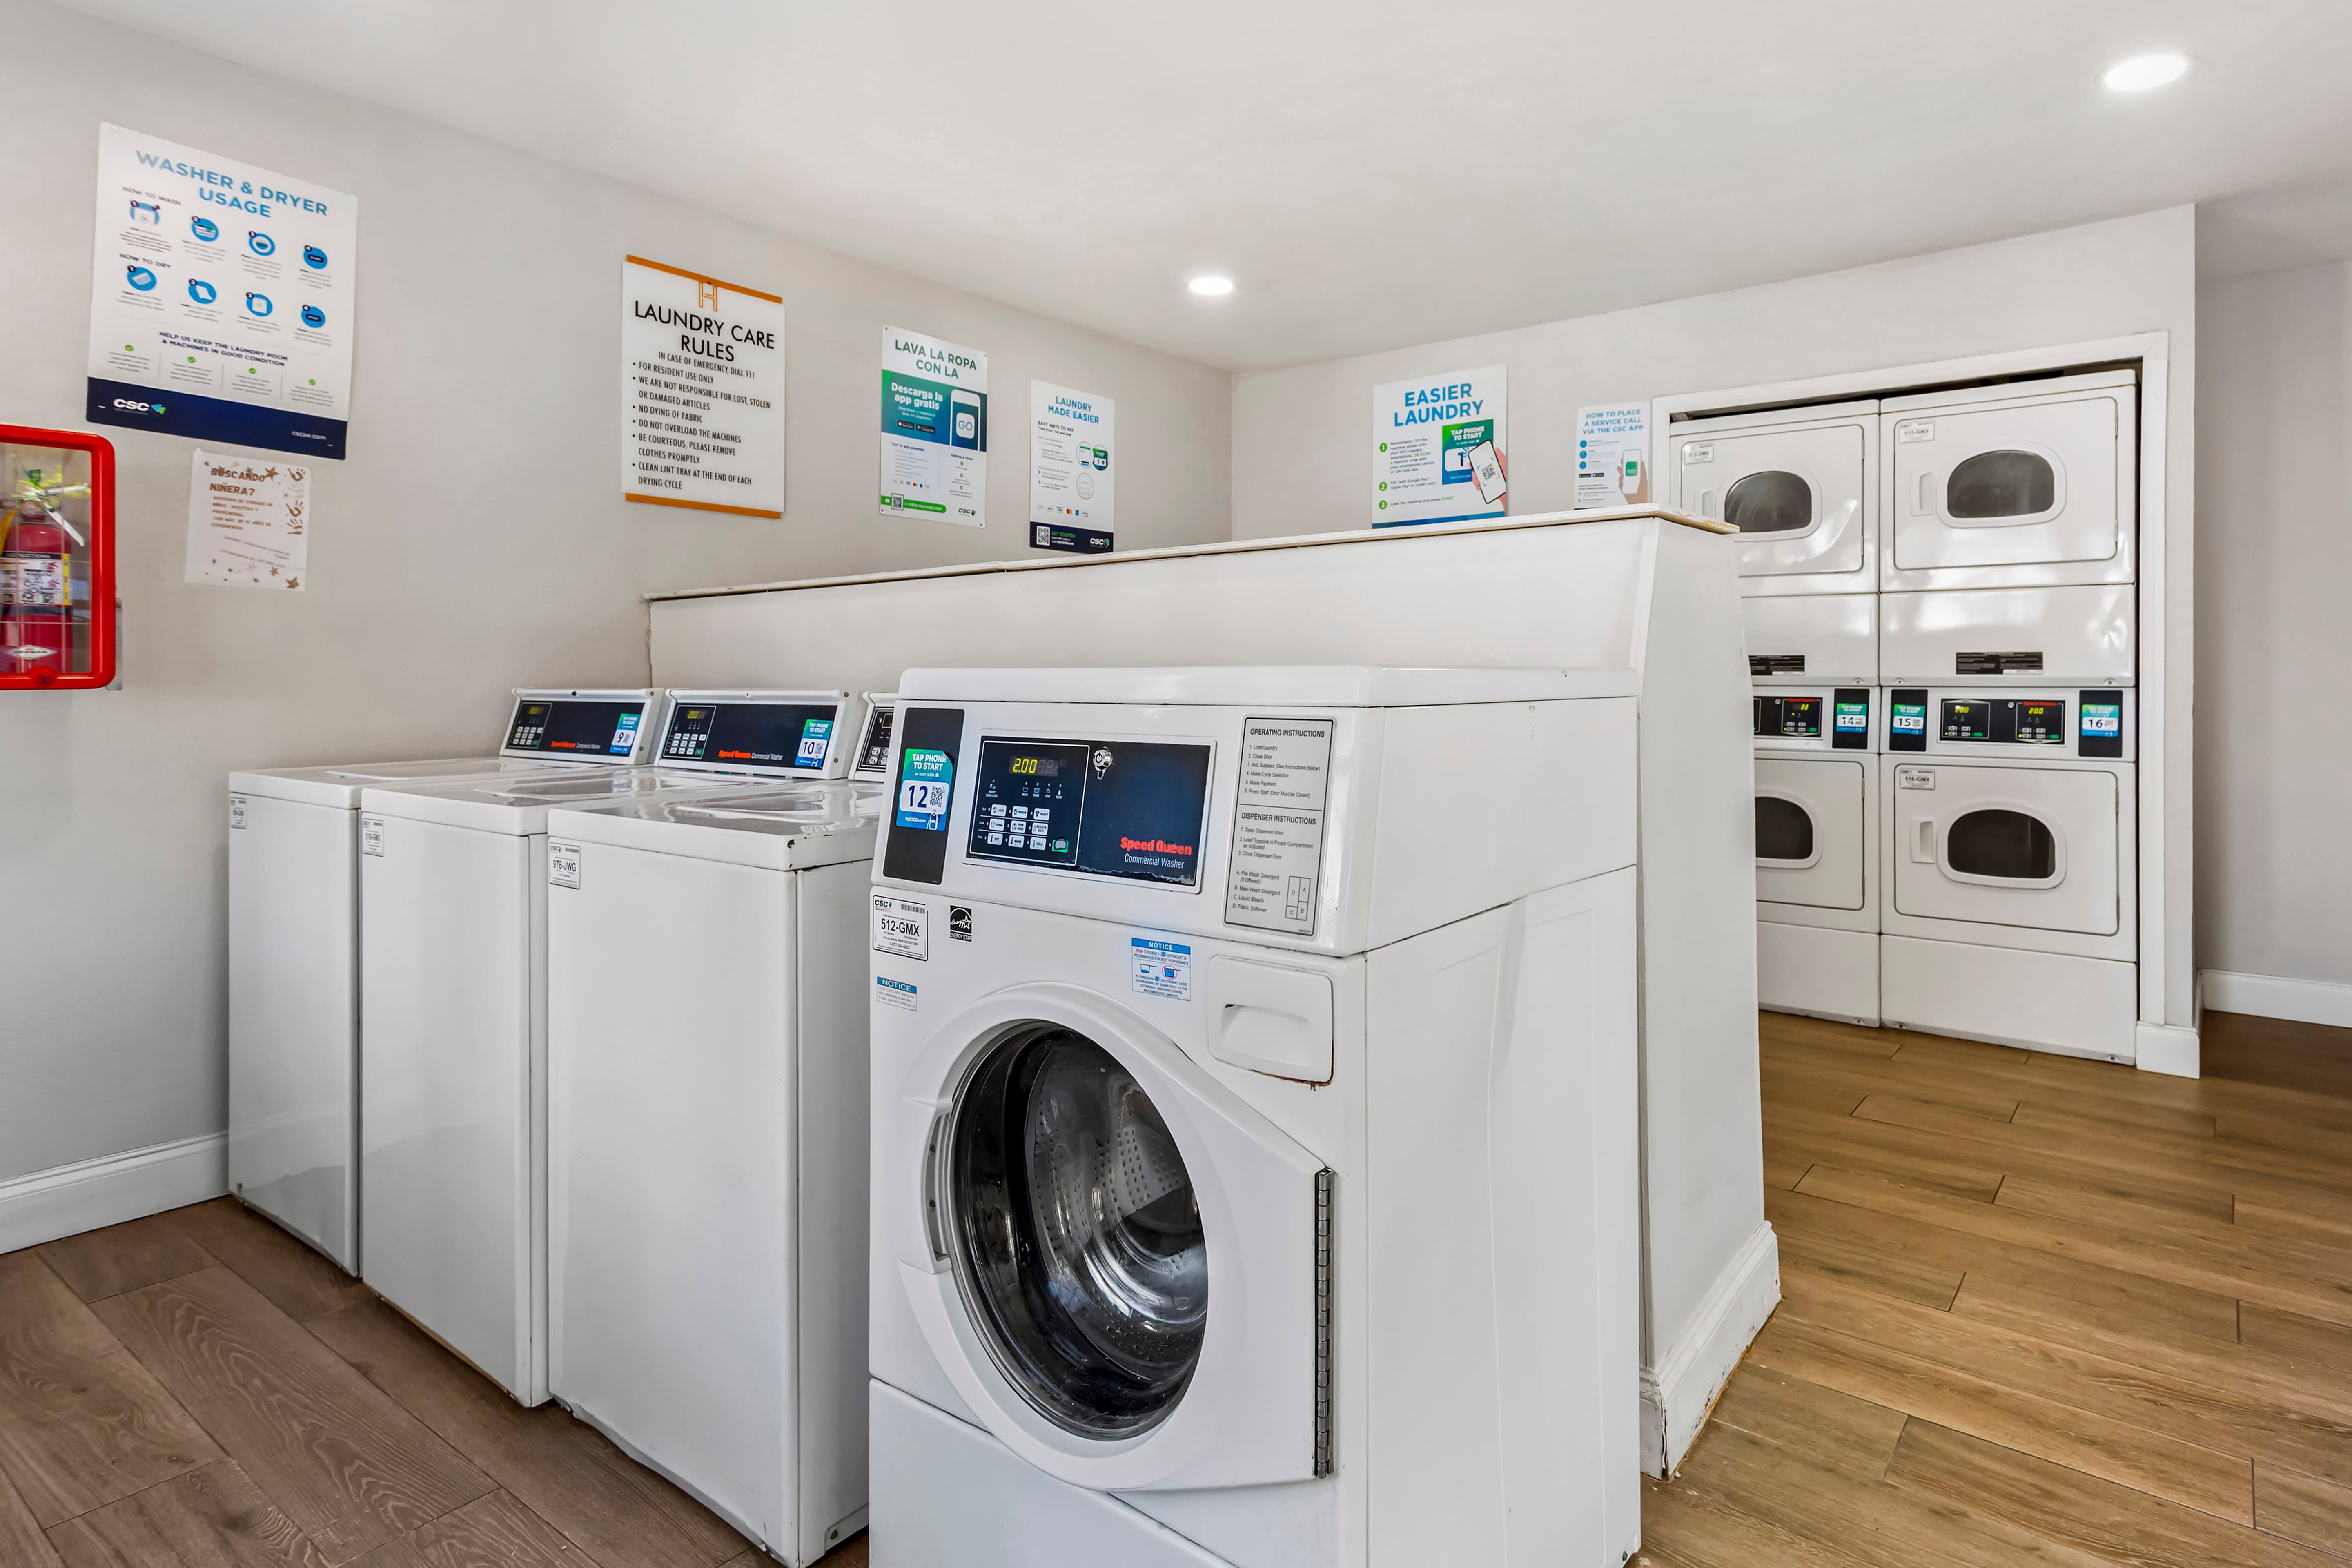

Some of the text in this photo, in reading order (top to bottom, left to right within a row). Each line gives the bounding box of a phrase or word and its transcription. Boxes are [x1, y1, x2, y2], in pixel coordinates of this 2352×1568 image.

[136, 151, 327, 216] WASHER & DRYER
[200, 187, 270, 217] USAGE
[635, 301, 774, 349] LAUNDRY CARE
[170, 341, 208, 351] MACHINES
[245, 355, 284, 366] CONDITION
[231, 346, 264, 355] LAUNDRY
[682, 335, 734, 361] RULES
[895, 339, 976, 370] LAVA LA ROPA
[639, 361, 713, 383] FOR RESIDENT USE ONLY
[667, 354, 682, 363] CASE
[694, 359, 728, 374] EMERGENCY,
[731, 367, 743, 376] DIAL
[746, 370, 754, 379] 911
[916, 359, 958, 379] CON LA
[639, 376, 770, 408] WE ARE NOT RESPONSIBLE FOR LOST, STOLEN
[639, 390, 709, 410] OR DAMAGED ARTICLES
[891, 382, 943, 401] Descarga la
[1405, 383, 1472, 406] EASIER
[114, 399, 149, 412] CSC
[895, 394, 939, 410] app gratis
[1056, 396, 1091, 412] LAUNDRY
[639, 405, 648, 413] NO
[650, 407, 669, 416] DYING
[682, 412, 702, 422] FABRIC
[1048, 405, 1098, 423] MADE EASIER
[1394, 400, 1483, 426] LAUNDRY
[639, 419, 741, 443] DO NOT OVERLOAD THE MACHINES
[958, 420, 973, 430] GO
[648, 435, 686, 448] COURTEOUS,
[689, 441, 710, 452] PLEASE
[713, 445, 735, 455] REMOVE
[639, 448, 699, 463] CLOTHES PROMPTLY
[211, 468, 265, 482] BUSCANDO
[639, 462, 658, 471] CLEAN
[661, 465, 674, 473] LINT
[676, 467, 690, 476] TRAY
[702, 471, 712, 479] THE
[737, 476, 751, 484] EACH
[210, 482, 255, 496] NIÑERA?
[639, 476, 681, 489] DRYING CYCLE
[1090, 537, 1104, 546] CSC
[1898, 718, 1911, 726] 15
[2088, 719, 2103, 728] 16
[617, 732, 624, 743] 9
[803, 742, 815, 755] 10
[909, 785, 928, 808] 12
[1242, 812, 1316, 824] DISPENSER INSTRUCTIONS
[1121, 837, 1192, 855] Speed Queen
[1125, 853, 1185, 869] Commercial Washer
[881, 918, 920, 937] 512-GMX
[1149, 942, 1173, 951] NOTICE
[882, 979, 912, 992] NOTICE
